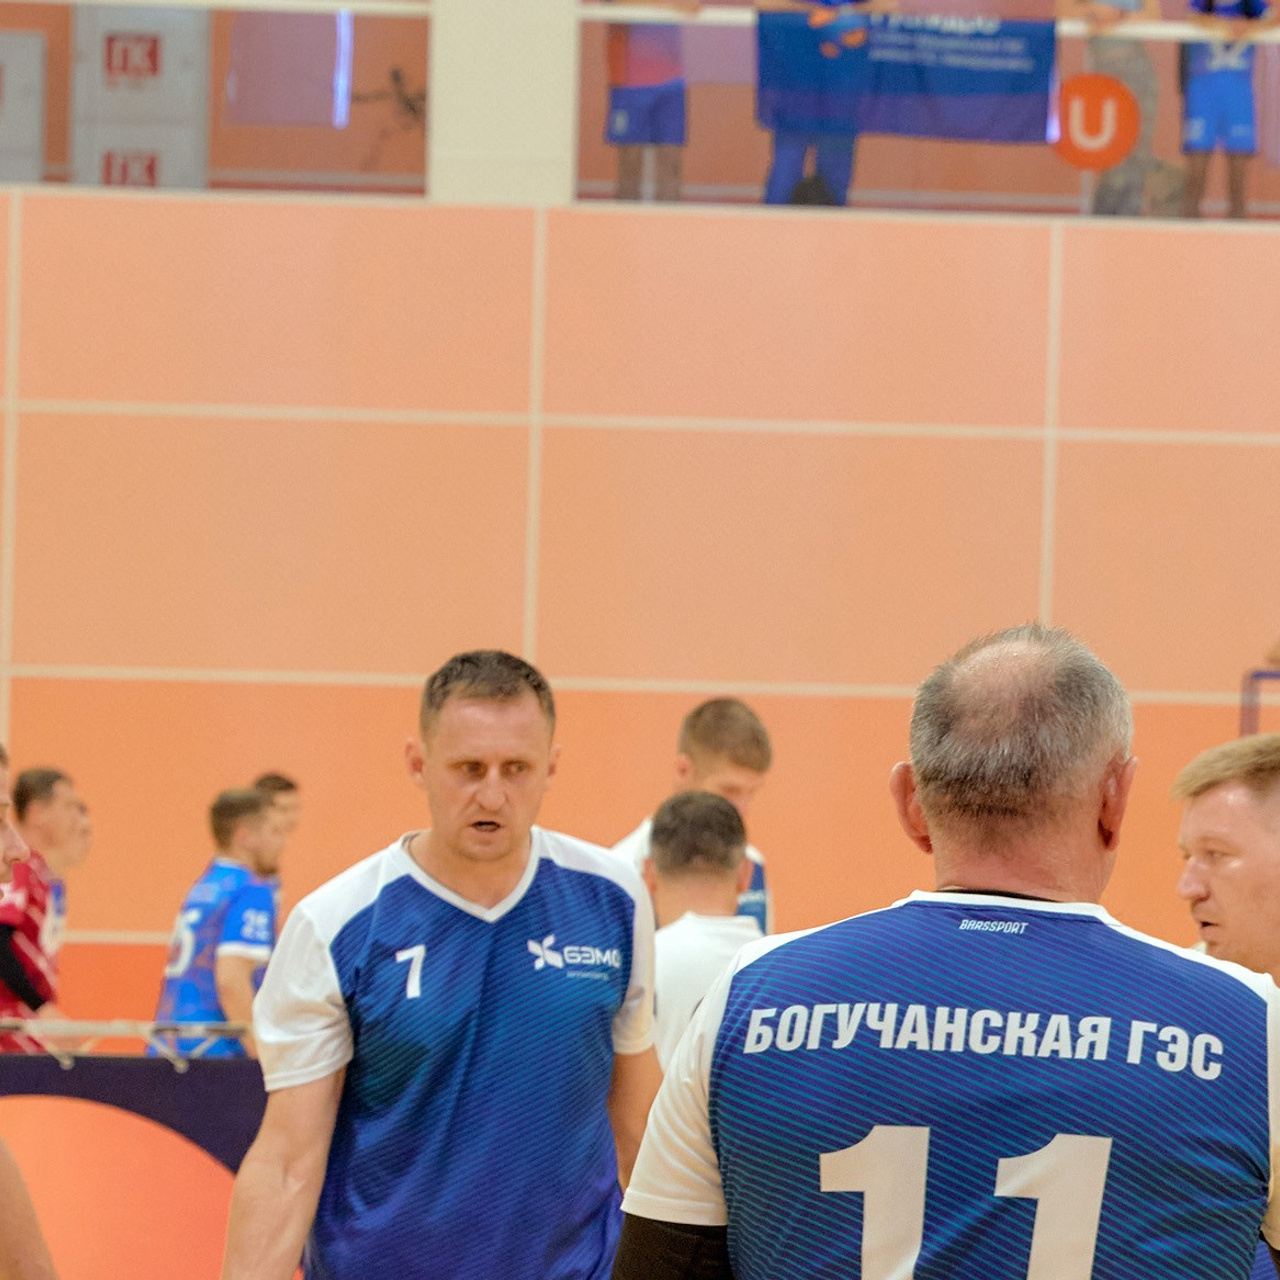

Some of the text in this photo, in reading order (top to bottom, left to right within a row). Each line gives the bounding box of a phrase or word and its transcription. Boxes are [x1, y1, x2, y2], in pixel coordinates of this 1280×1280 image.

[1069, 98, 1117, 148] U
[959, 919, 1029, 934] BARSSPORT
[396, 945, 426, 998] 7
[743, 1003, 1225, 1081] БОГУЧАНСКАЯ ГЭС
